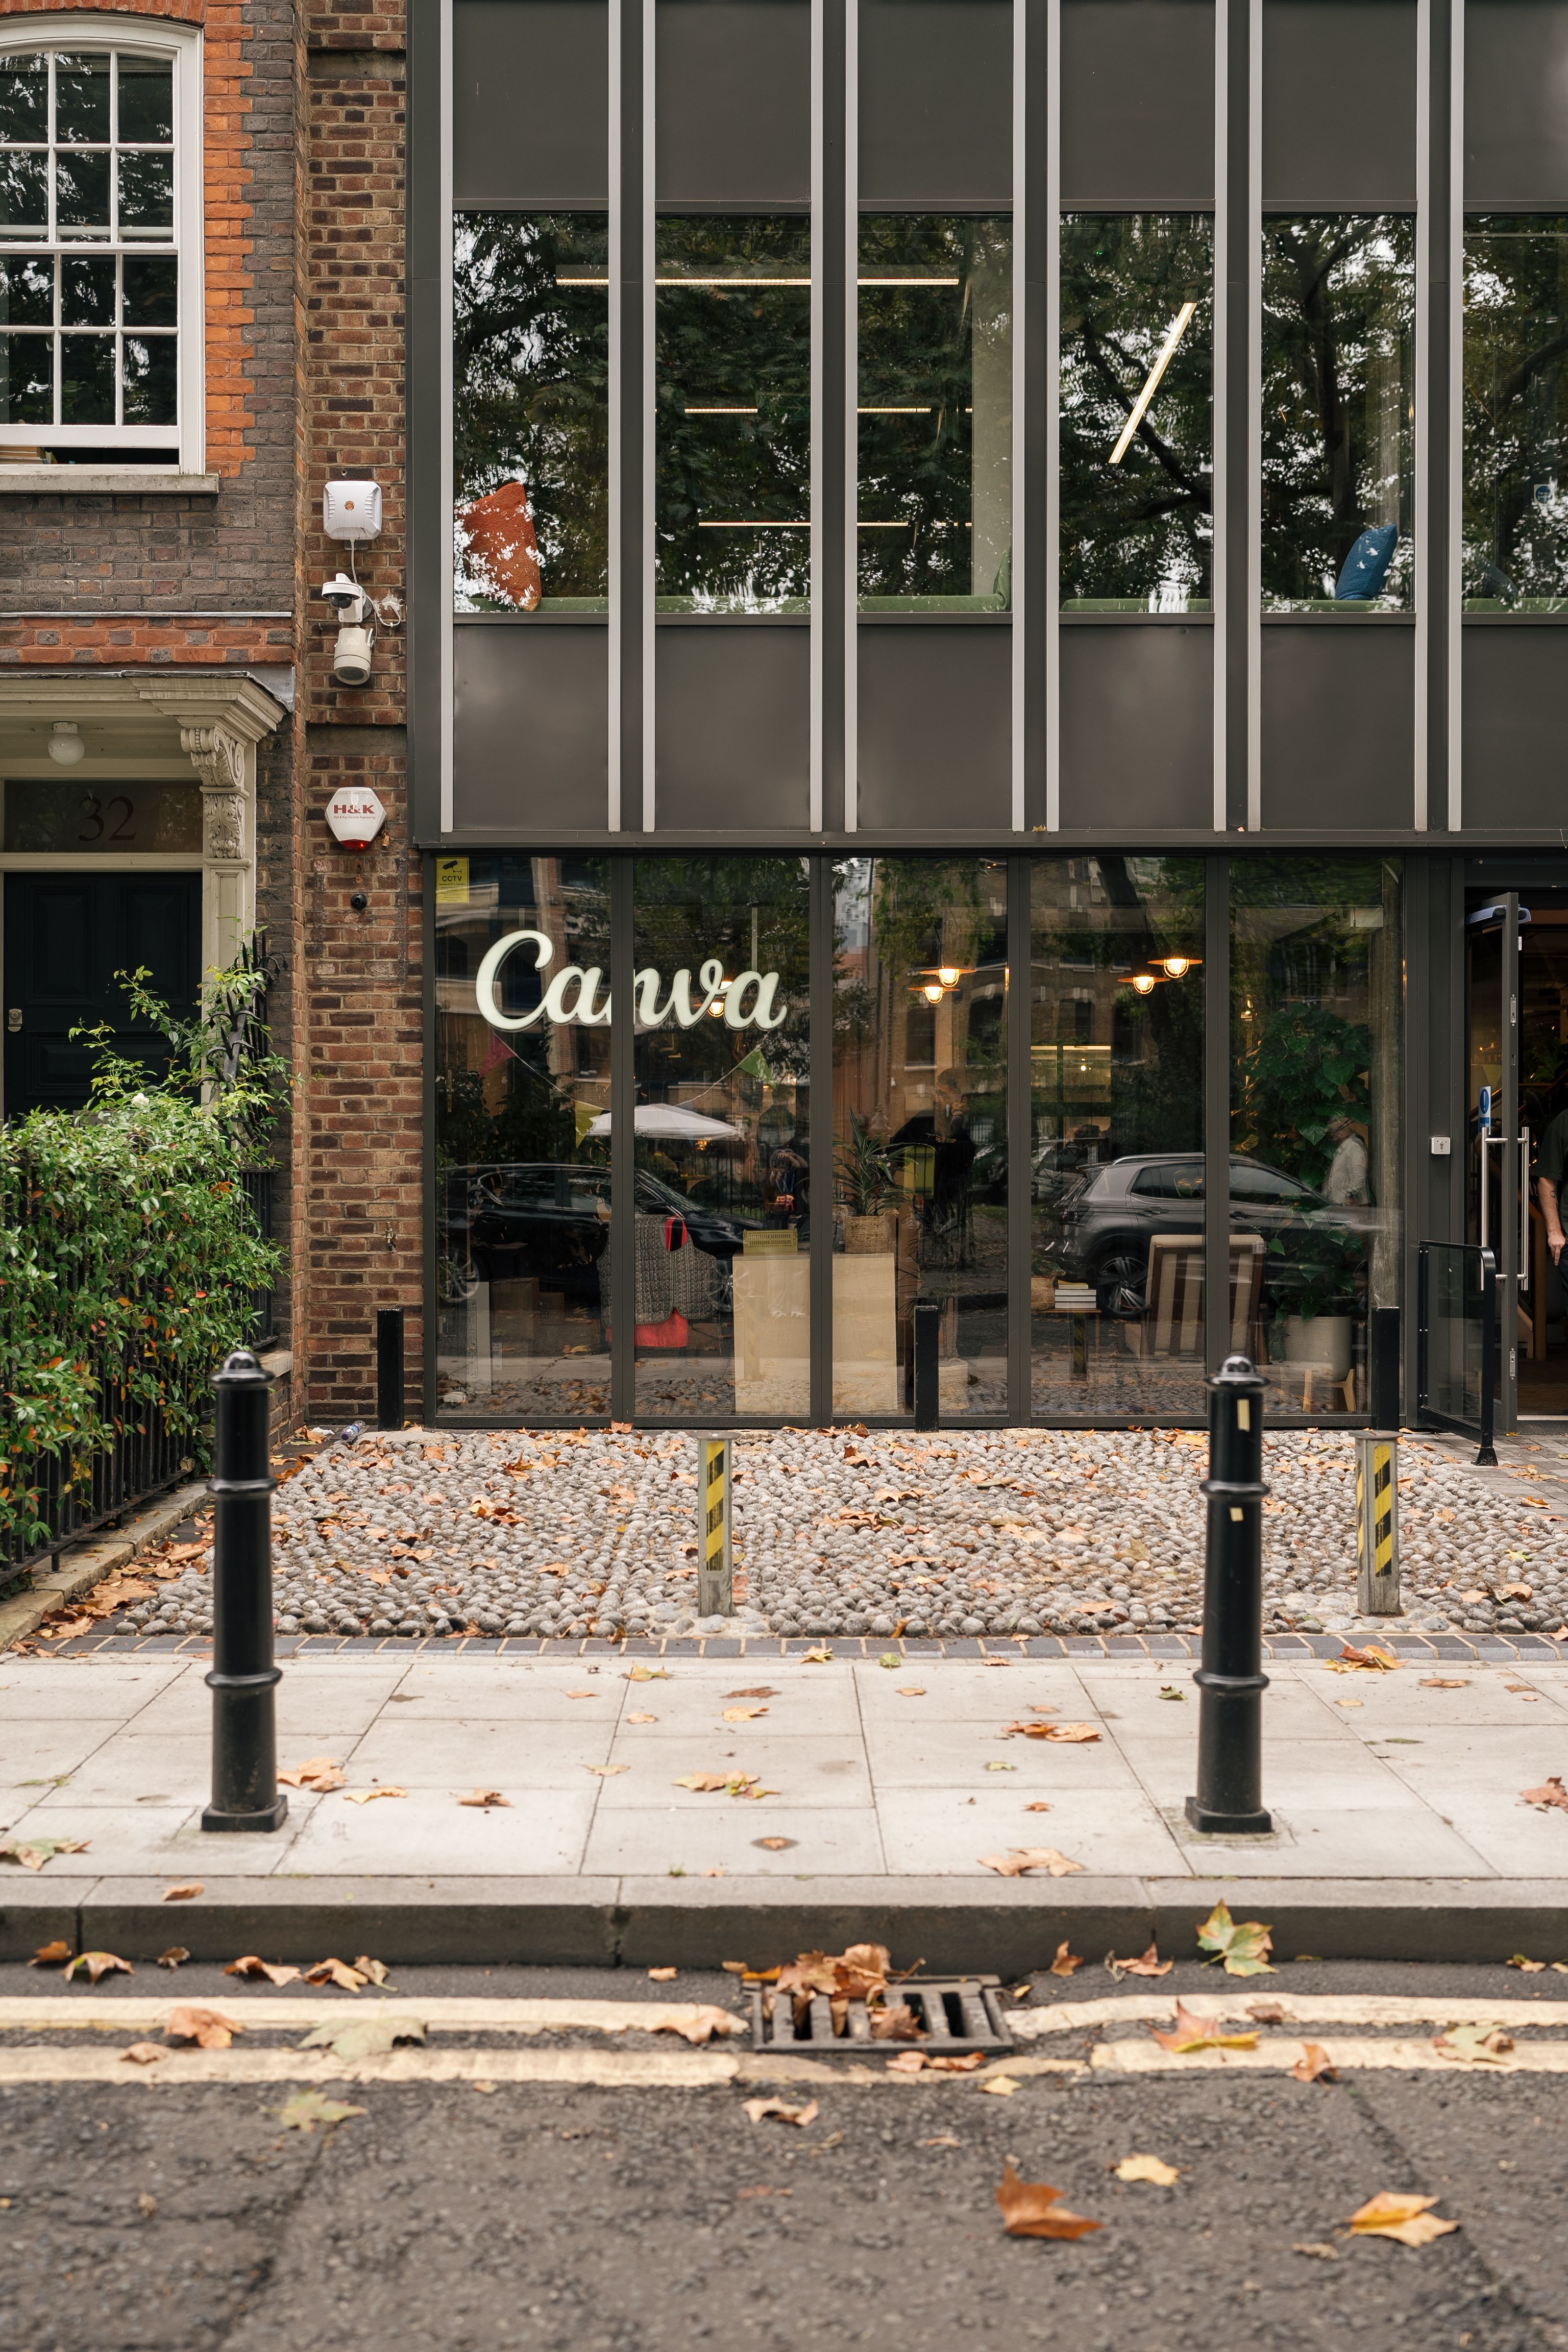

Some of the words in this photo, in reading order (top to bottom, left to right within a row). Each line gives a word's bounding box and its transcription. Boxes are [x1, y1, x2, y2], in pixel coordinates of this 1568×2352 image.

[78, 796, 137, 841] 32
[334, 804, 375, 814] H&K
[476, 929, 788, 1032] Canva
